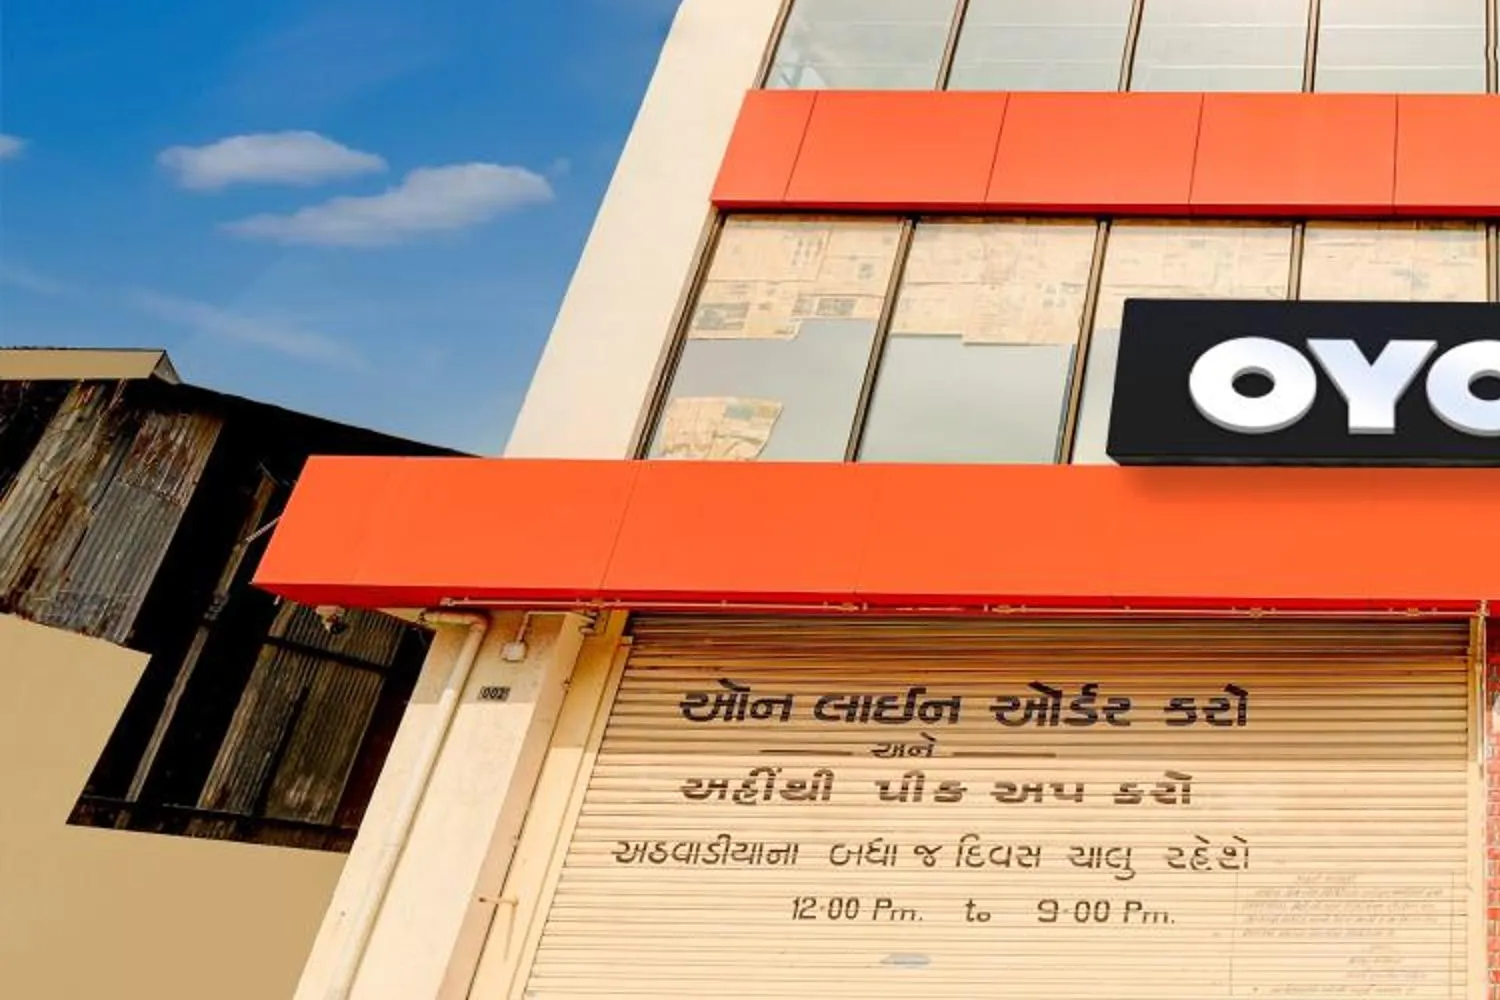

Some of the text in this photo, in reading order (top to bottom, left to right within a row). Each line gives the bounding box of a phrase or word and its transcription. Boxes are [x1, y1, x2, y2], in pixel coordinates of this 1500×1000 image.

[679, 678, 1249, 727] ઓન લાઈન ઓર્ડર કરો
[870, 732, 936, 758] અને
[680, 766, 1192, 805] અહીંથી પીક અપ કરો
[611, 833, 1250, 880] અઠવાડીયાના બધા જ દિવસ ચાલુ રહેશે
[965, 898, 991, 923] to
